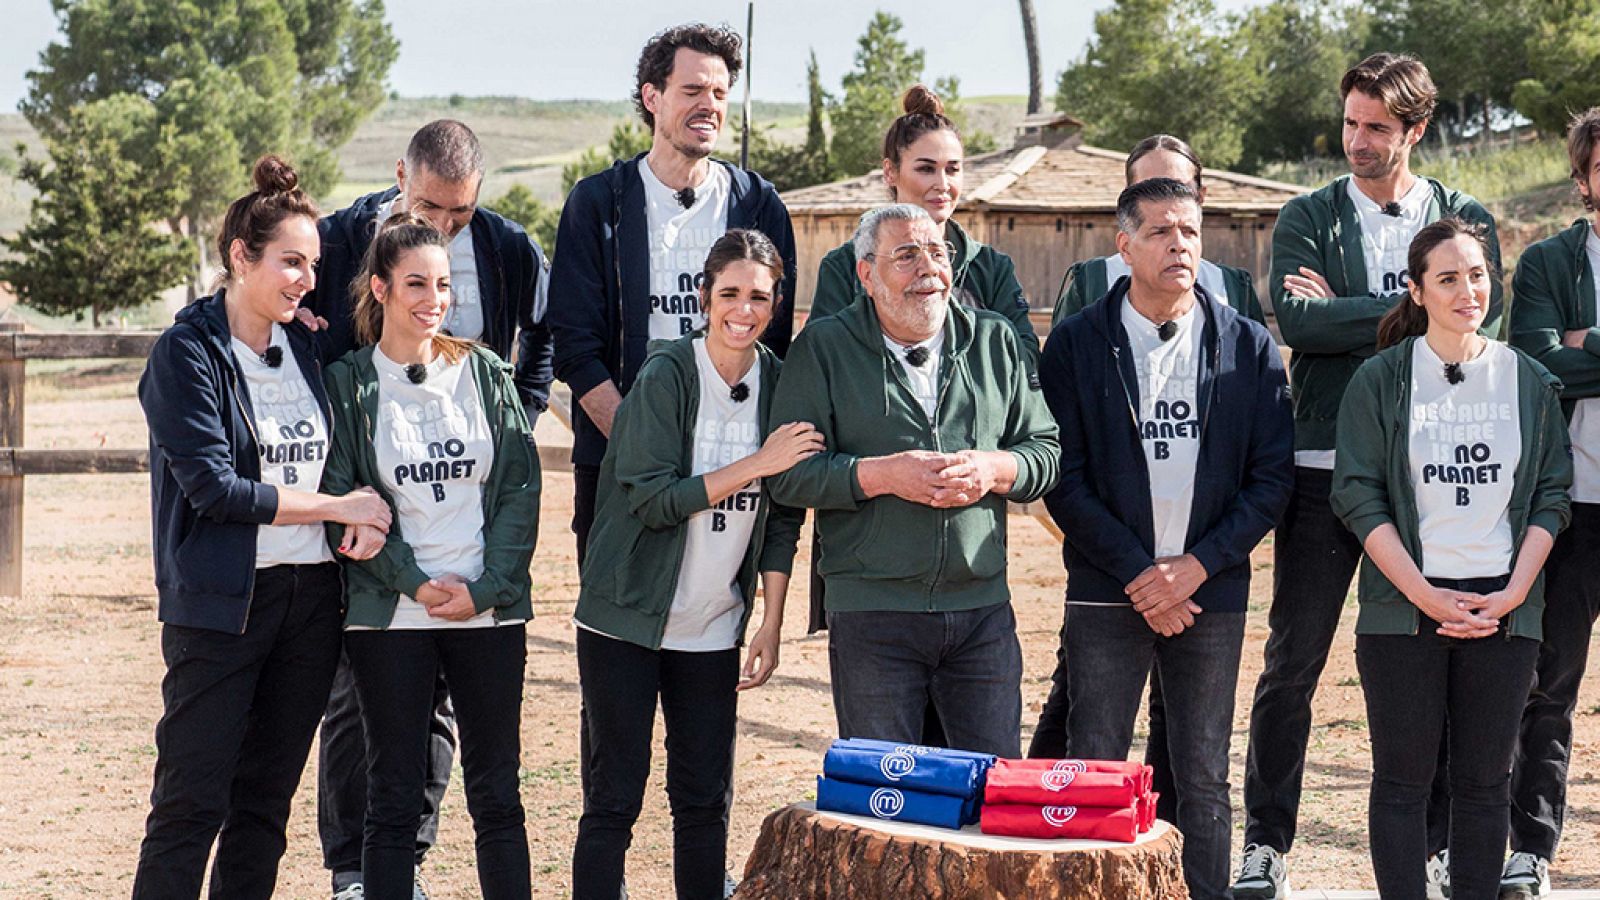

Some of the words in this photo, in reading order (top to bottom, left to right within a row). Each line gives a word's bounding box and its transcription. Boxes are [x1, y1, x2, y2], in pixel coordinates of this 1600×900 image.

[650, 295, 699, 314] PLAN
[680, 317, 693, 335] B
[1155, 400, 1191, 420] NO
[1413, 402, 1512, 422] BECAUSE
[279, 420, 315, 440] NO
[1140, 420, 1200, 439] LANET
[1425, 421, 1496, 443] THERE
[427, 438, 466, 459] NO
[1154, 441, 1170, 460] B
[1432, 443, 1451, 463] IS
[1455, 442, 1490, 464] NO
[283, 465, 298, 485] B
[394, 458, 476, 486] PLANET
[1422, 463, 1502, 485] PLANET
[431, 482, 446, 503] B
[1455, 486, 1470, 506] B
[711, 512, 726, 532] B
